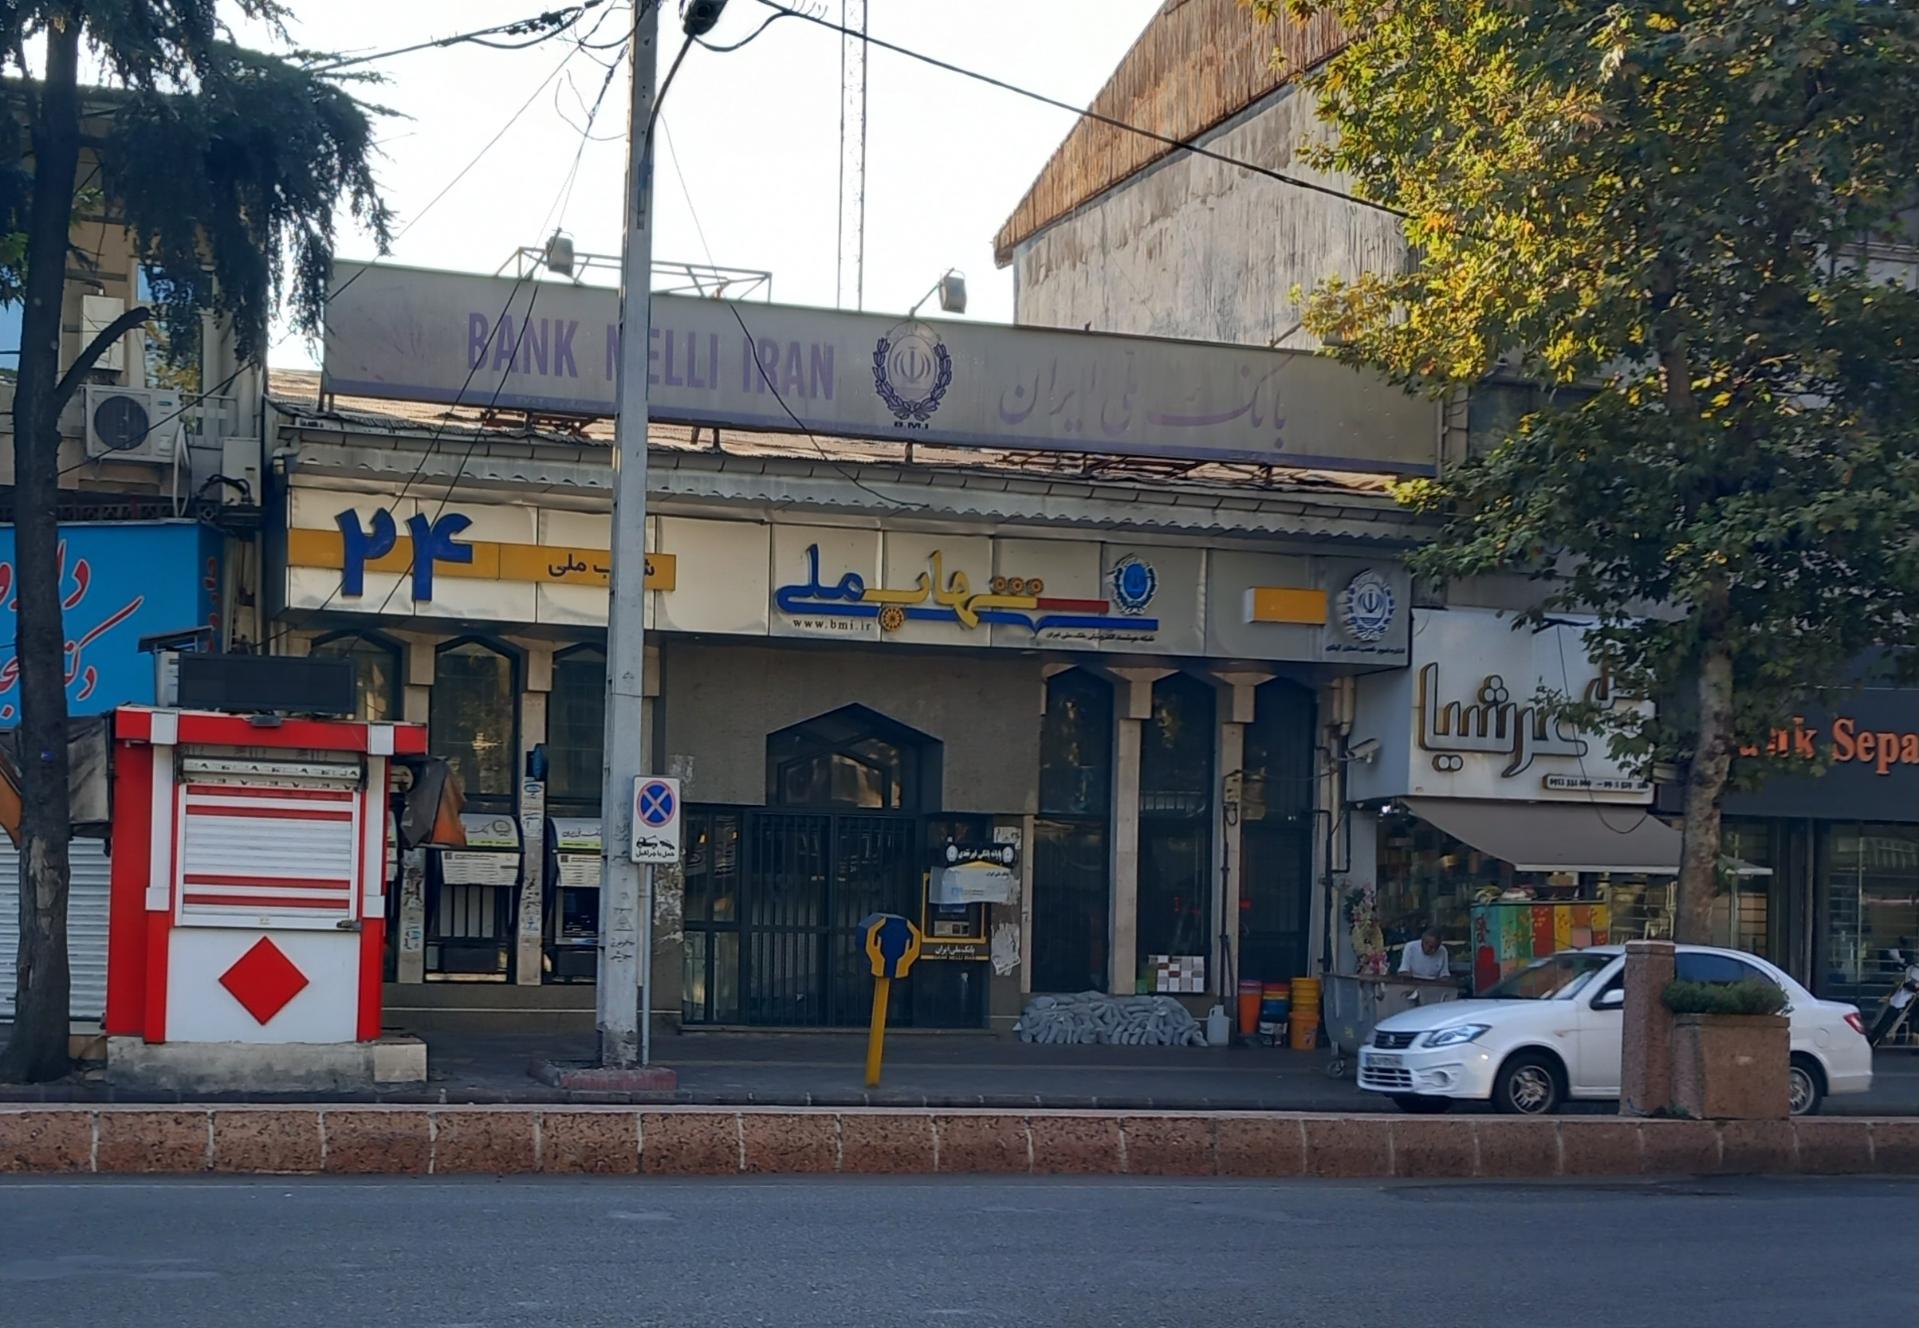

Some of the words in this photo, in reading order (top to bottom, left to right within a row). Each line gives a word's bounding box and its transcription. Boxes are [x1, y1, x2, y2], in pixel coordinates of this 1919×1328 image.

[467, 312, 579, 378] BANK
[742, 335, 835, 401] IRAN
[547, 552, 588, 577] ملی
[792, 618, 872, 632] www.bmi.ir
